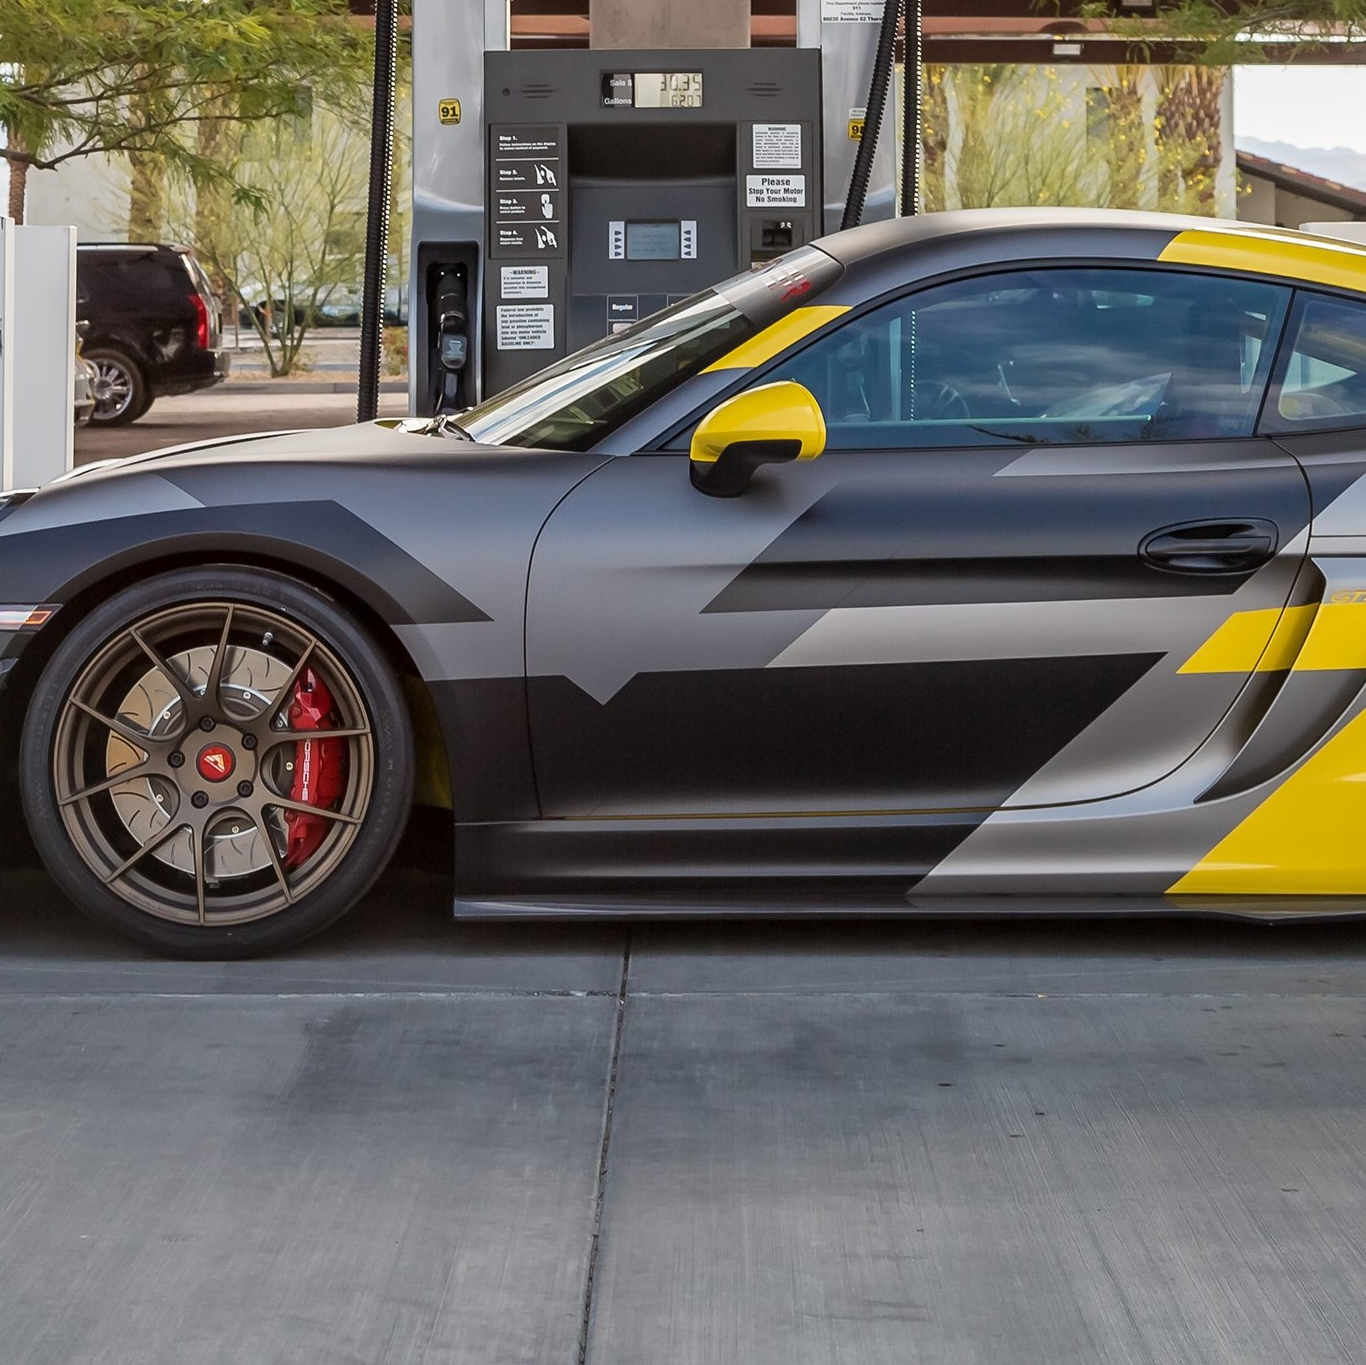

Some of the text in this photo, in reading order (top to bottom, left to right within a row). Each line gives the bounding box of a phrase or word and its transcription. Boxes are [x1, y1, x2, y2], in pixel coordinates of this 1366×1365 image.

[610, 78, 626, 87] Sale
[660, 74, 701, 91] 30.35
[604, 97, 632, 105] Gallons
[441, 106, 459, 118] 91
[302, 739, 311, 800] ORSCHE
